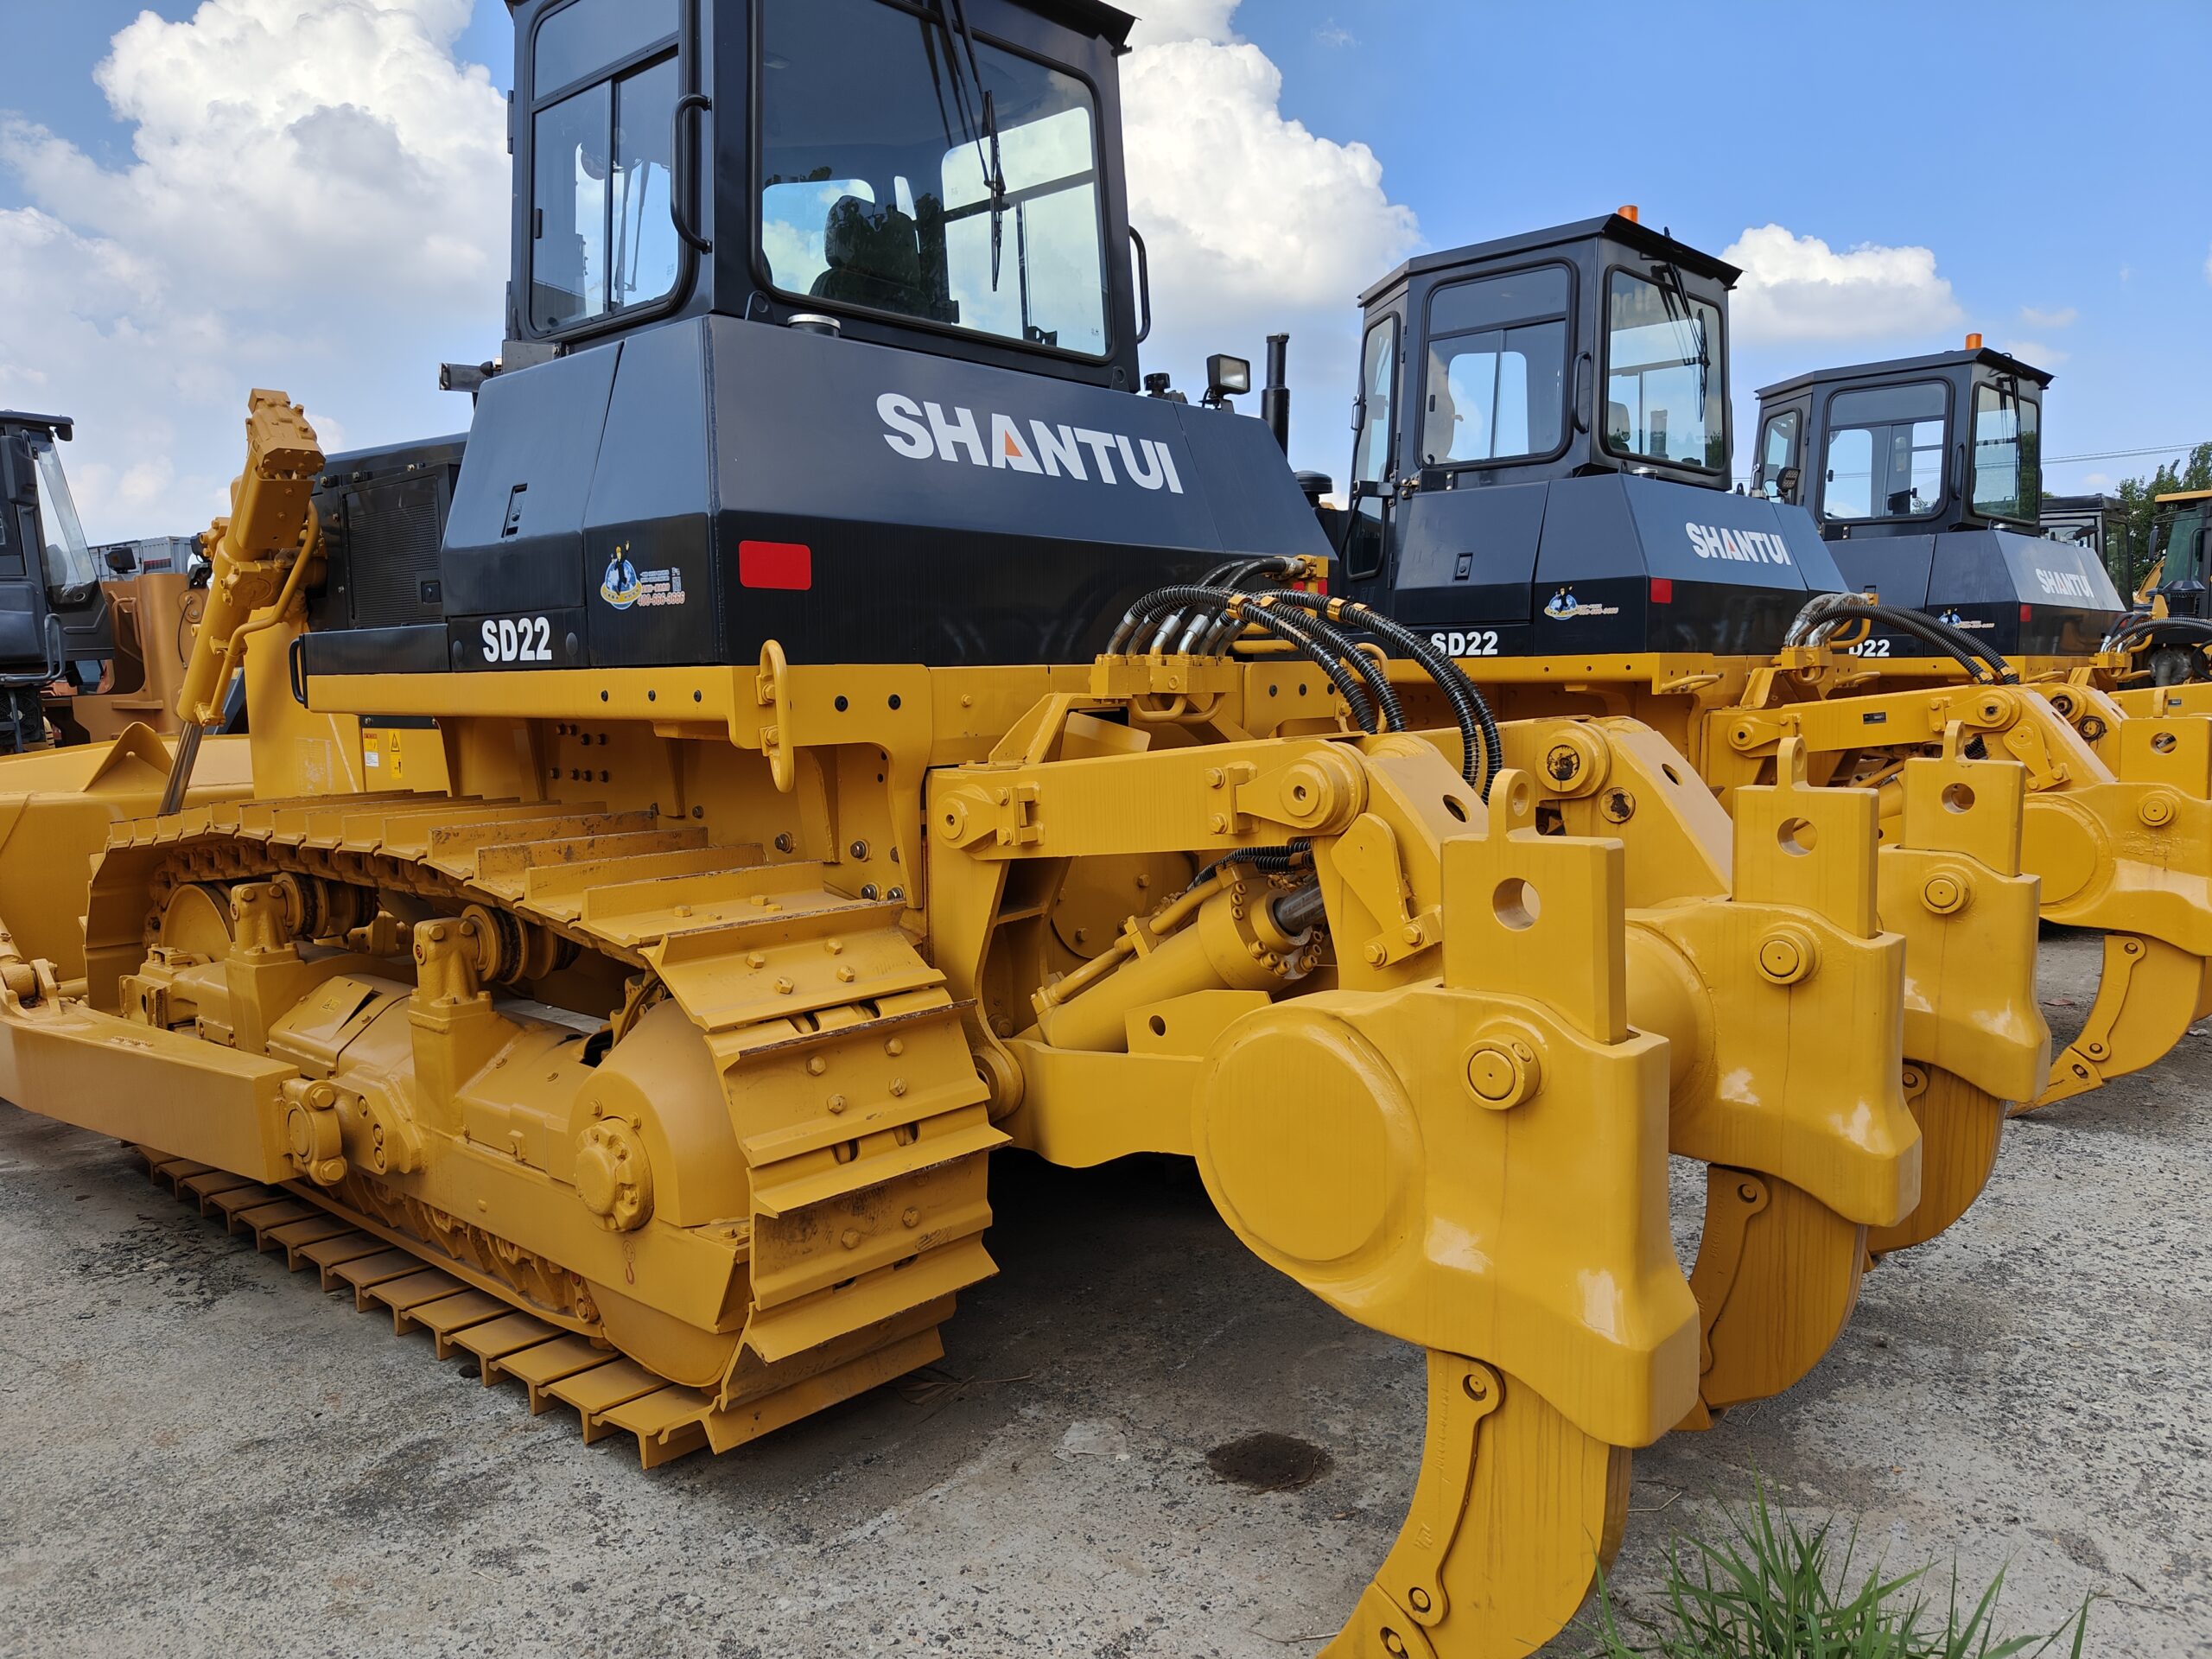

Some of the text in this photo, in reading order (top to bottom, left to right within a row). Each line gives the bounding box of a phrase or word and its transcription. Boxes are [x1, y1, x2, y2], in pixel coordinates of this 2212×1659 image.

[876, 392, 1184, 494] SHANTUI
[1685, 522, 1792, 566] SHANTUI
[2035, 568, 2094, 598] SHANTUI
[481, 616, 552, 663] SD22
[1430, 631, 1498, 656] SD22
